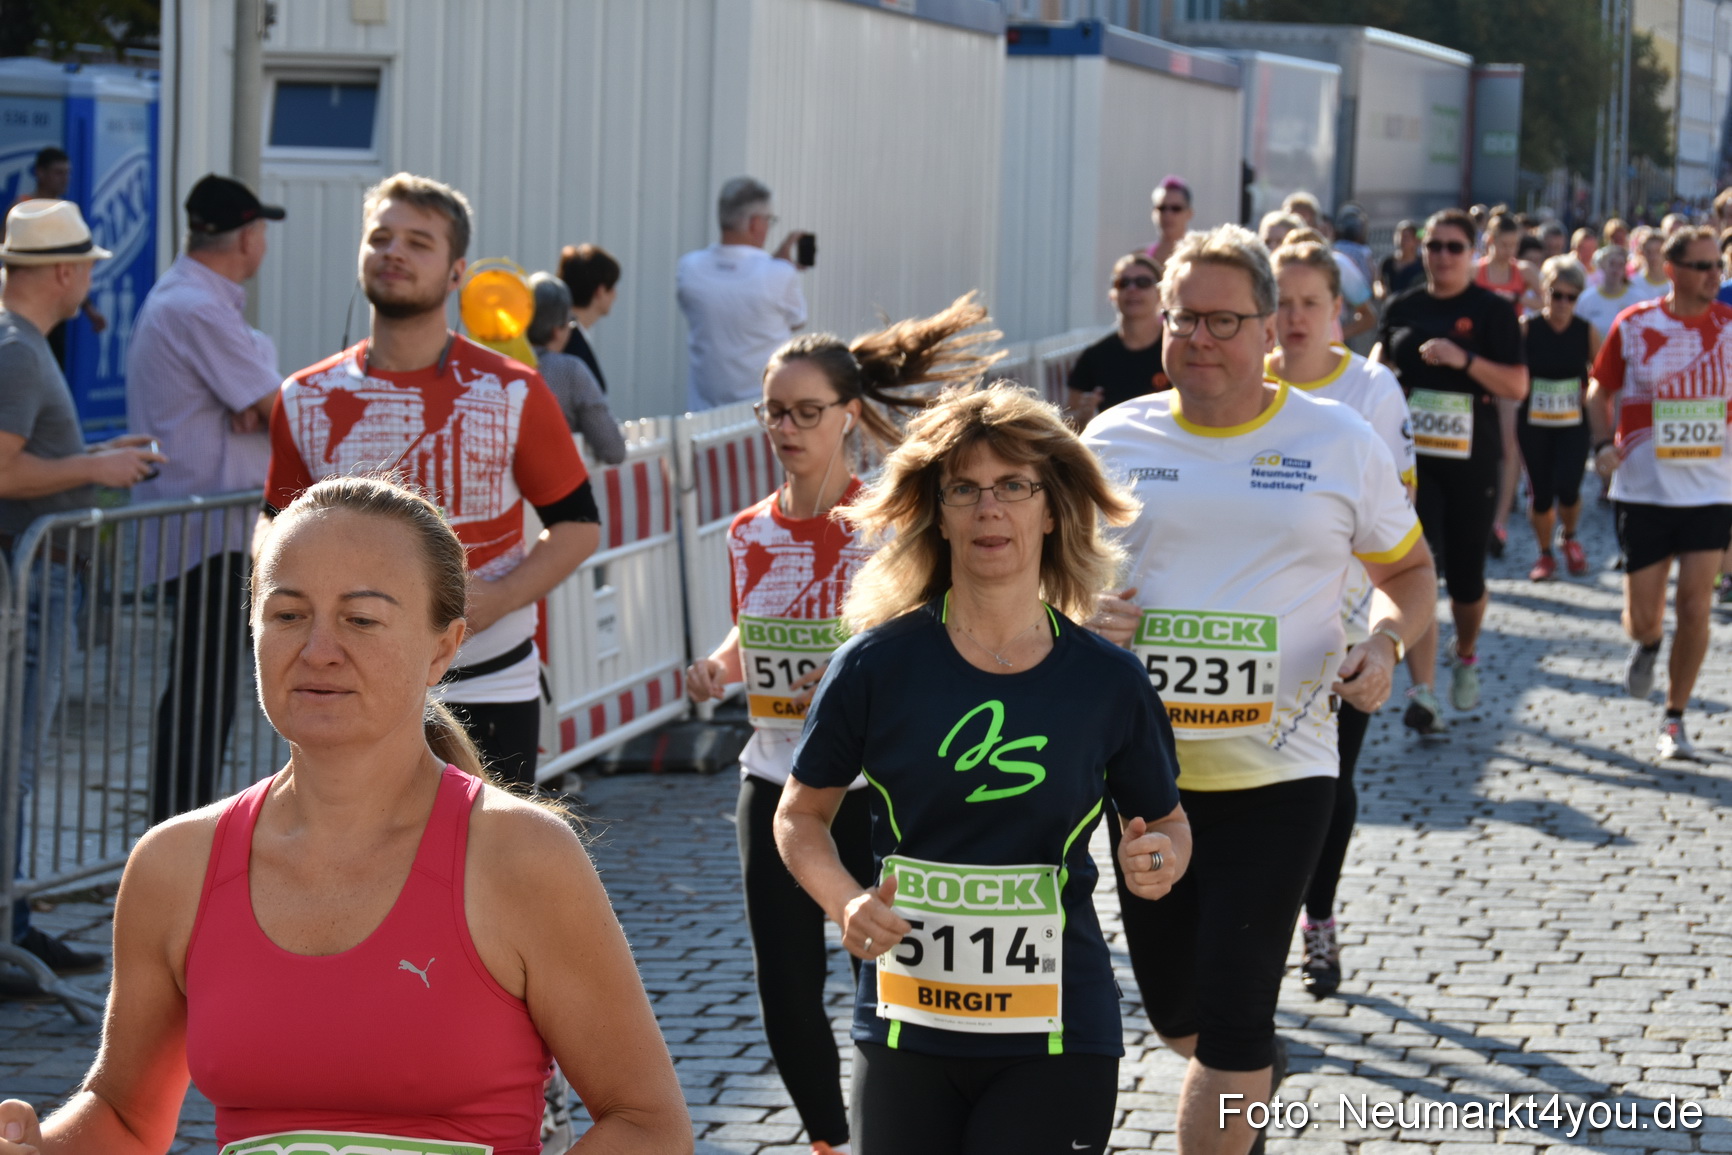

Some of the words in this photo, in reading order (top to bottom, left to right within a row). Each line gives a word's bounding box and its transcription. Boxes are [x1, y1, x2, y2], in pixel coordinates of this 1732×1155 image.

[1411, 411, 1466, 436] 5066
[1663, 422, 1718, 444] 5202
[1250, 480, 1305, 492] Stadtlauf
[1251, 468, 1318, 482] Neumarkter
[746, 622, 840, 647] BOCK
[1144, 614, 1265, 646] BOCK
[754, 656, 831, 690] 519
[1146, 654, 1257, 695] 5231
[1167, 706, 1260, 725] RNHARD
[896, 867, 1043, 909] BOCK
[896, 920, 1039, 973] 5114
[918, 986, 1012, 1012] BIRGIT
